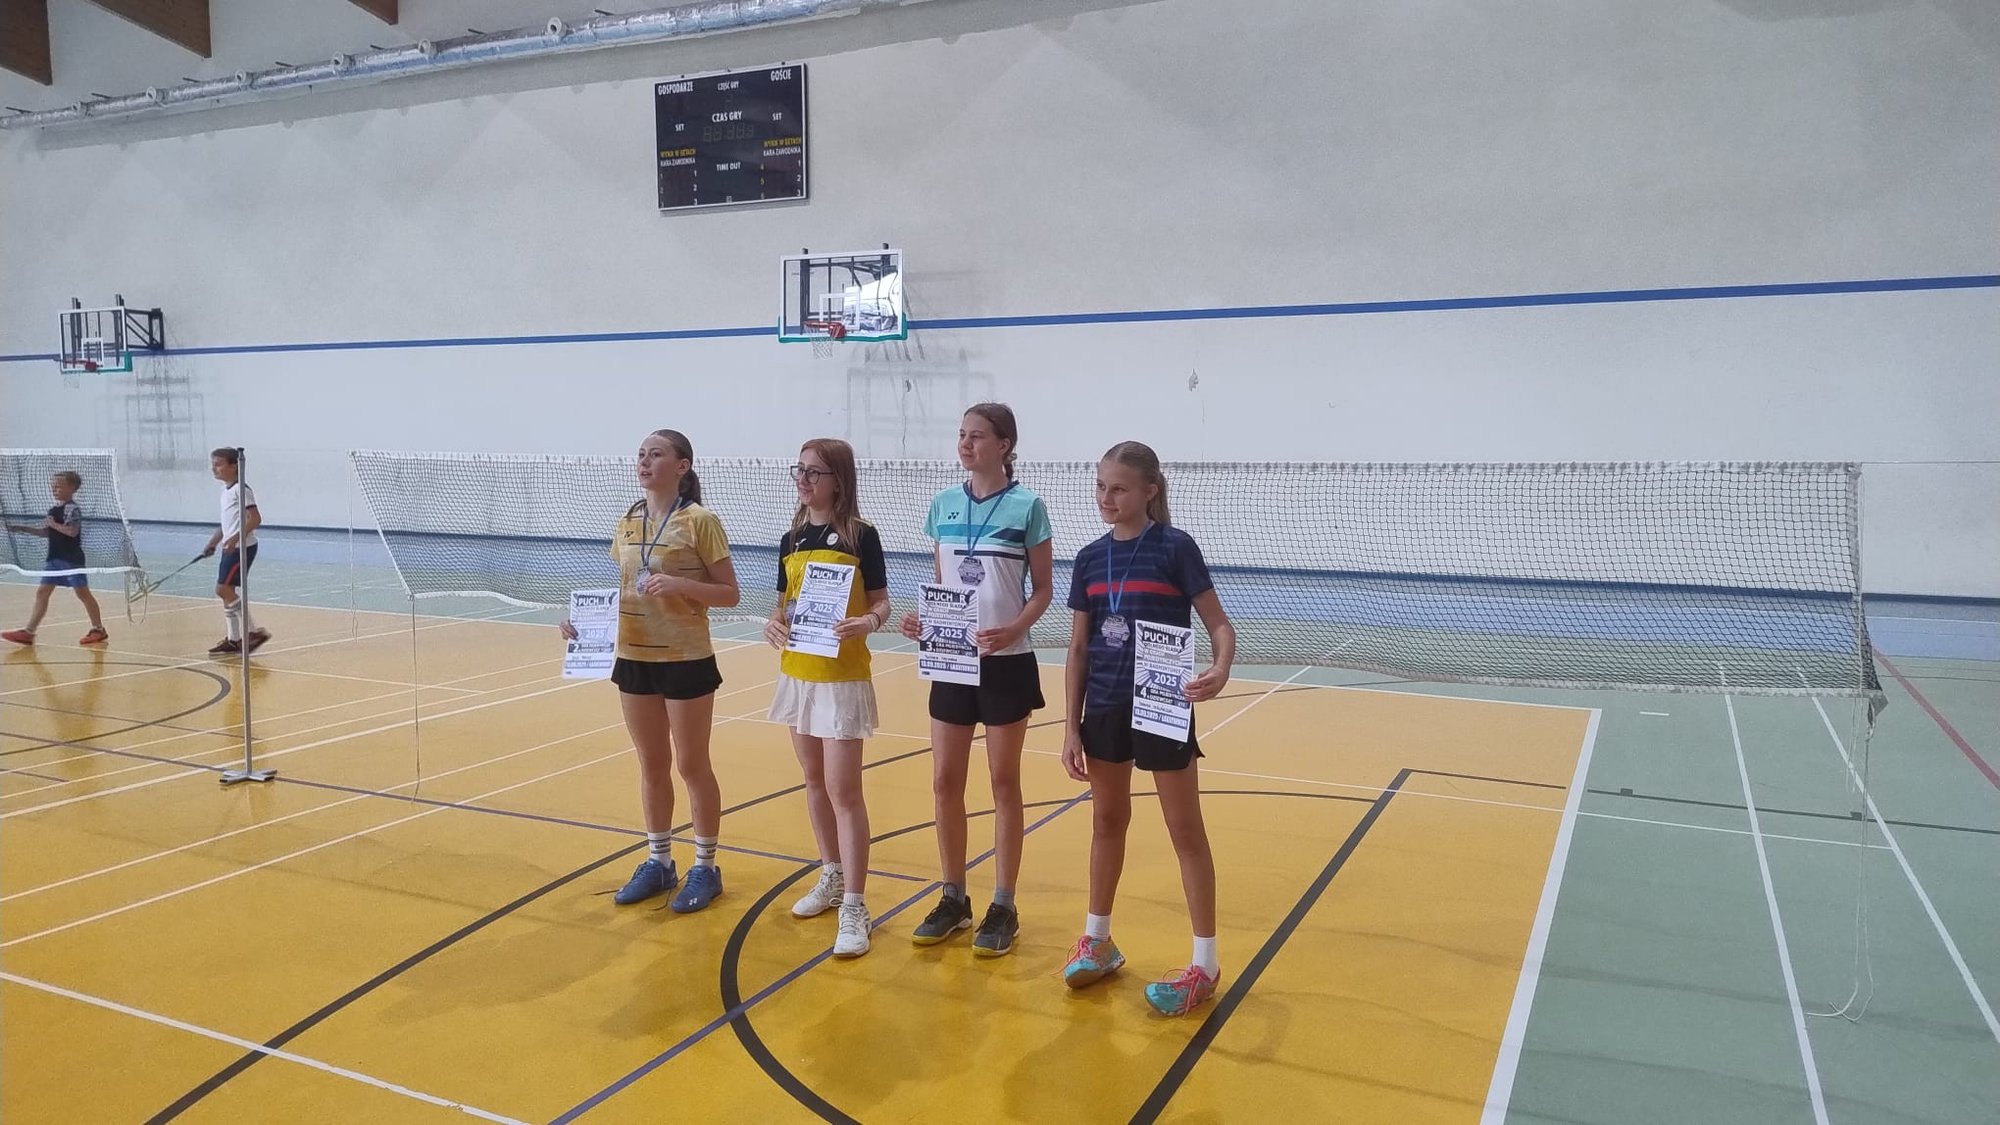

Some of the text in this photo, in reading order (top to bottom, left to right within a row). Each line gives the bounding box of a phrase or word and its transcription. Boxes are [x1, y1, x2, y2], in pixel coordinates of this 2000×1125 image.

[771, 69, 791, 81] GOŚCIE
[658, 81, 694, 96] GOSPODARZE
[712, 111, 742, 123] CZAS GRY
[772, 112, 782, 121] SET
[675, 123, 685, 132] SET
[716, 162, 741, 171] TIME OUT
[812, 570, 843, 581] PUCHR
[927, 590, 966, 604] PUCHR
[813, 603, 833, 613] 2025
[939, 628, 963, 639] 2025
[1144, 631, 1182, 647] PUCHR
[1154, 672, 1177, 687] 2025
